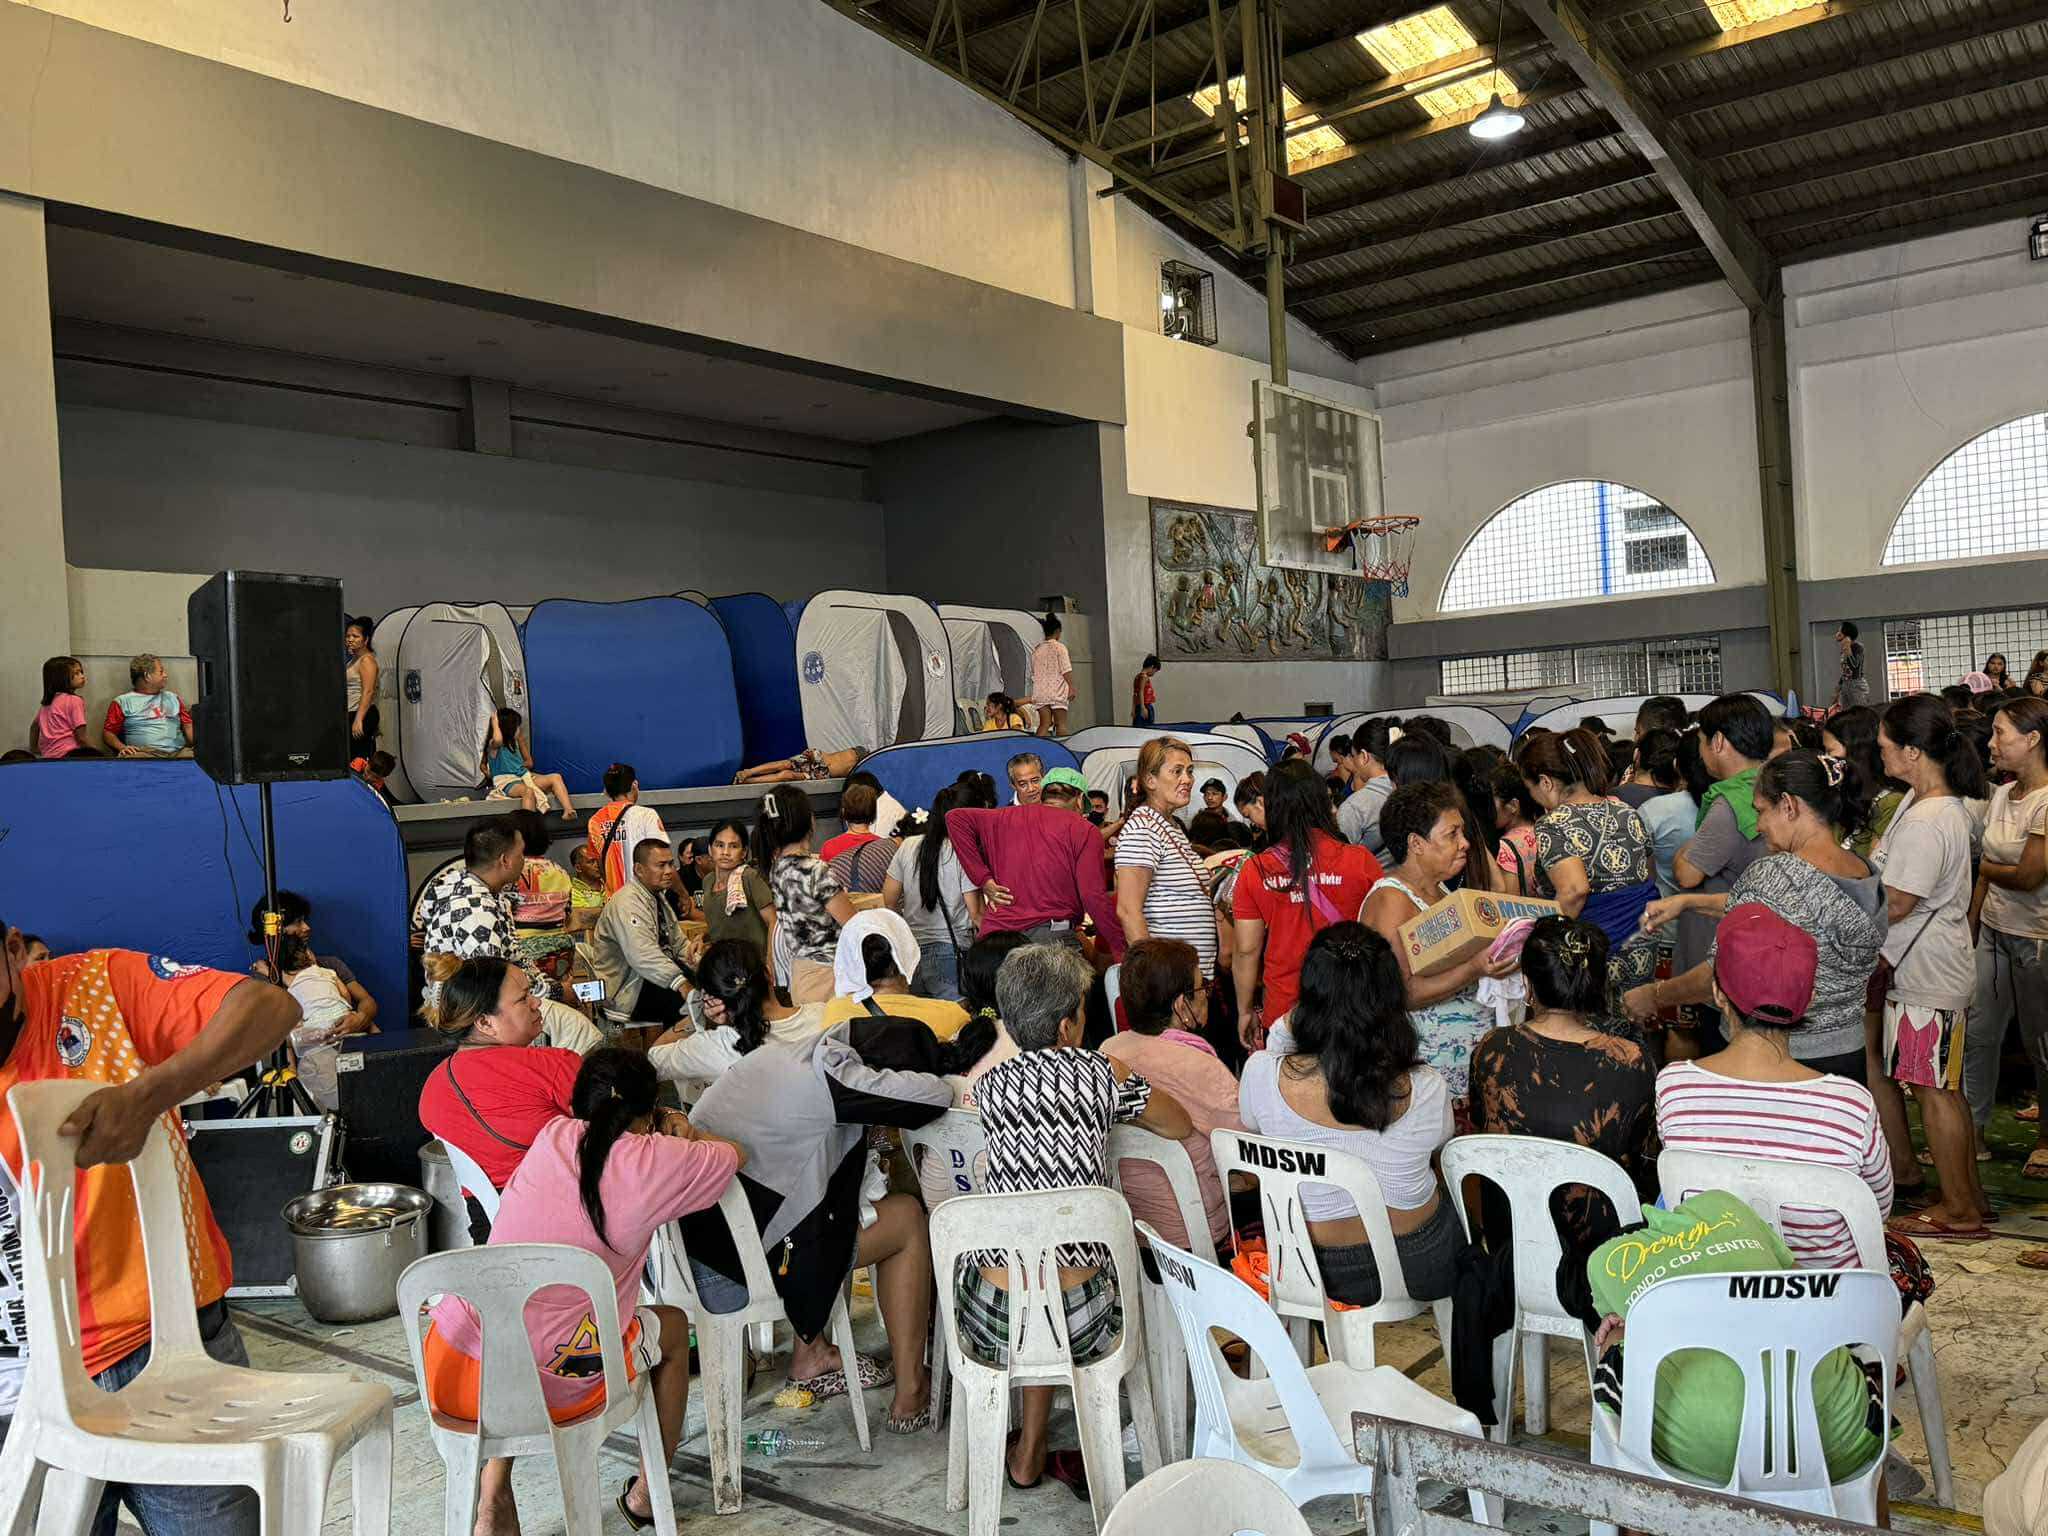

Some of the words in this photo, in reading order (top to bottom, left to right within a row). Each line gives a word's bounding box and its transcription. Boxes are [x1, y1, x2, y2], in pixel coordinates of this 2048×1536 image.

[1237, 1138, 1326, 1177] MDSW
[1624, 1265, 1667, 1307] TONDO
[1669, 1250, 1702, 1268] CDP
[1705, 1238, 1765, 1256] CENTER
[1729, 1274, 1841, 1299] MDSW
